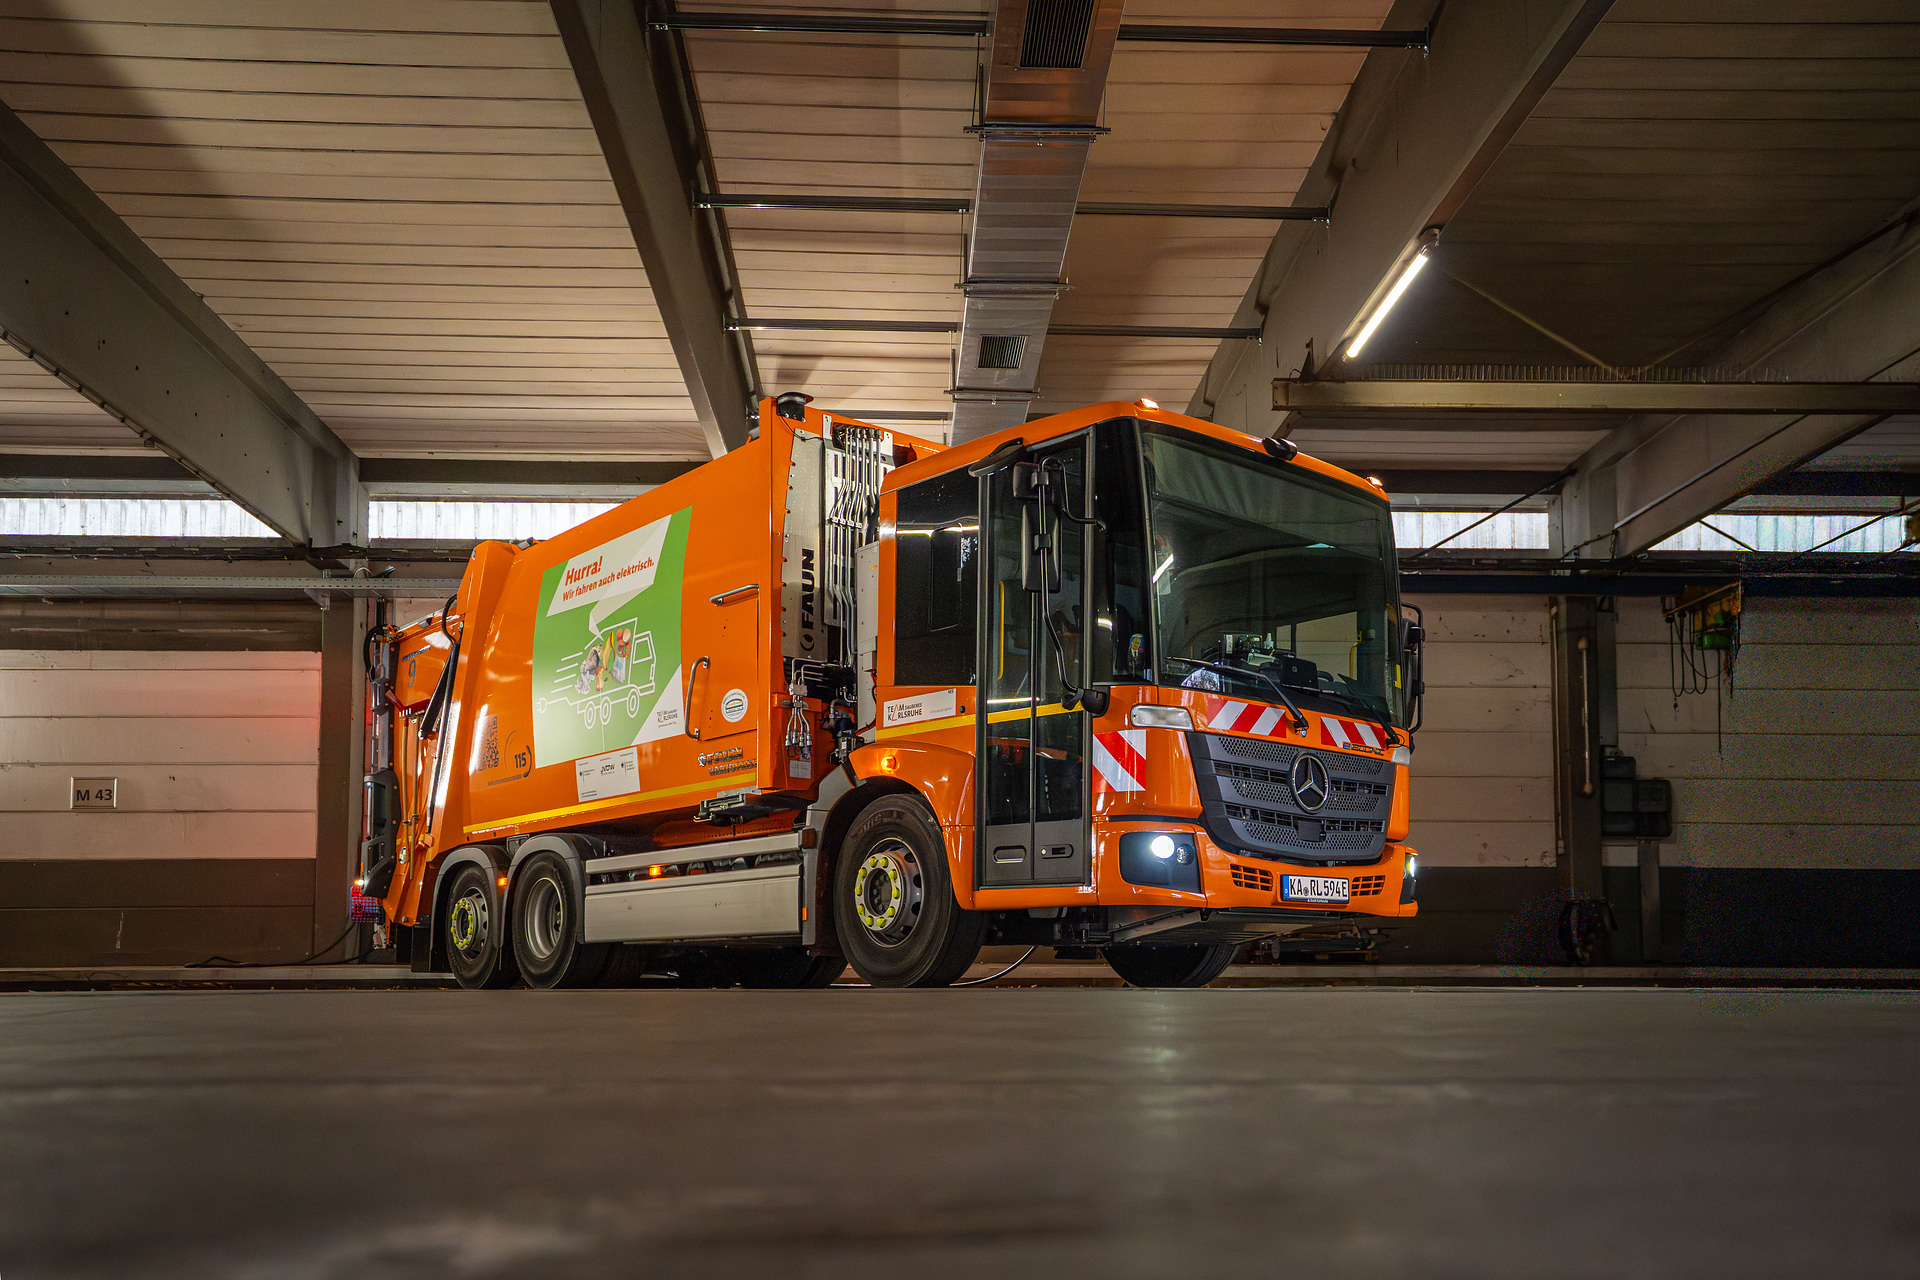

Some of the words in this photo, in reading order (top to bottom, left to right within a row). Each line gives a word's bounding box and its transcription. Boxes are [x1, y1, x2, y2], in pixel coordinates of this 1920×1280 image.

[562, 589, 574, 602] Wir
[575, 580, 597, 596] fahren
[598, 572, 615, 588] auch
[616, 556, 655, 579] elektrisch.
[565, 555, 603, 586] Hurra!
[801, 548, 814, 629] FAUN
[408, 659, 416, 688] 9
[514, 752, 527, 769] 115
[76, 789, 90, 801] M
[95, 789, 113, 801] 43
[1290, 879, 1303, 896] KA
